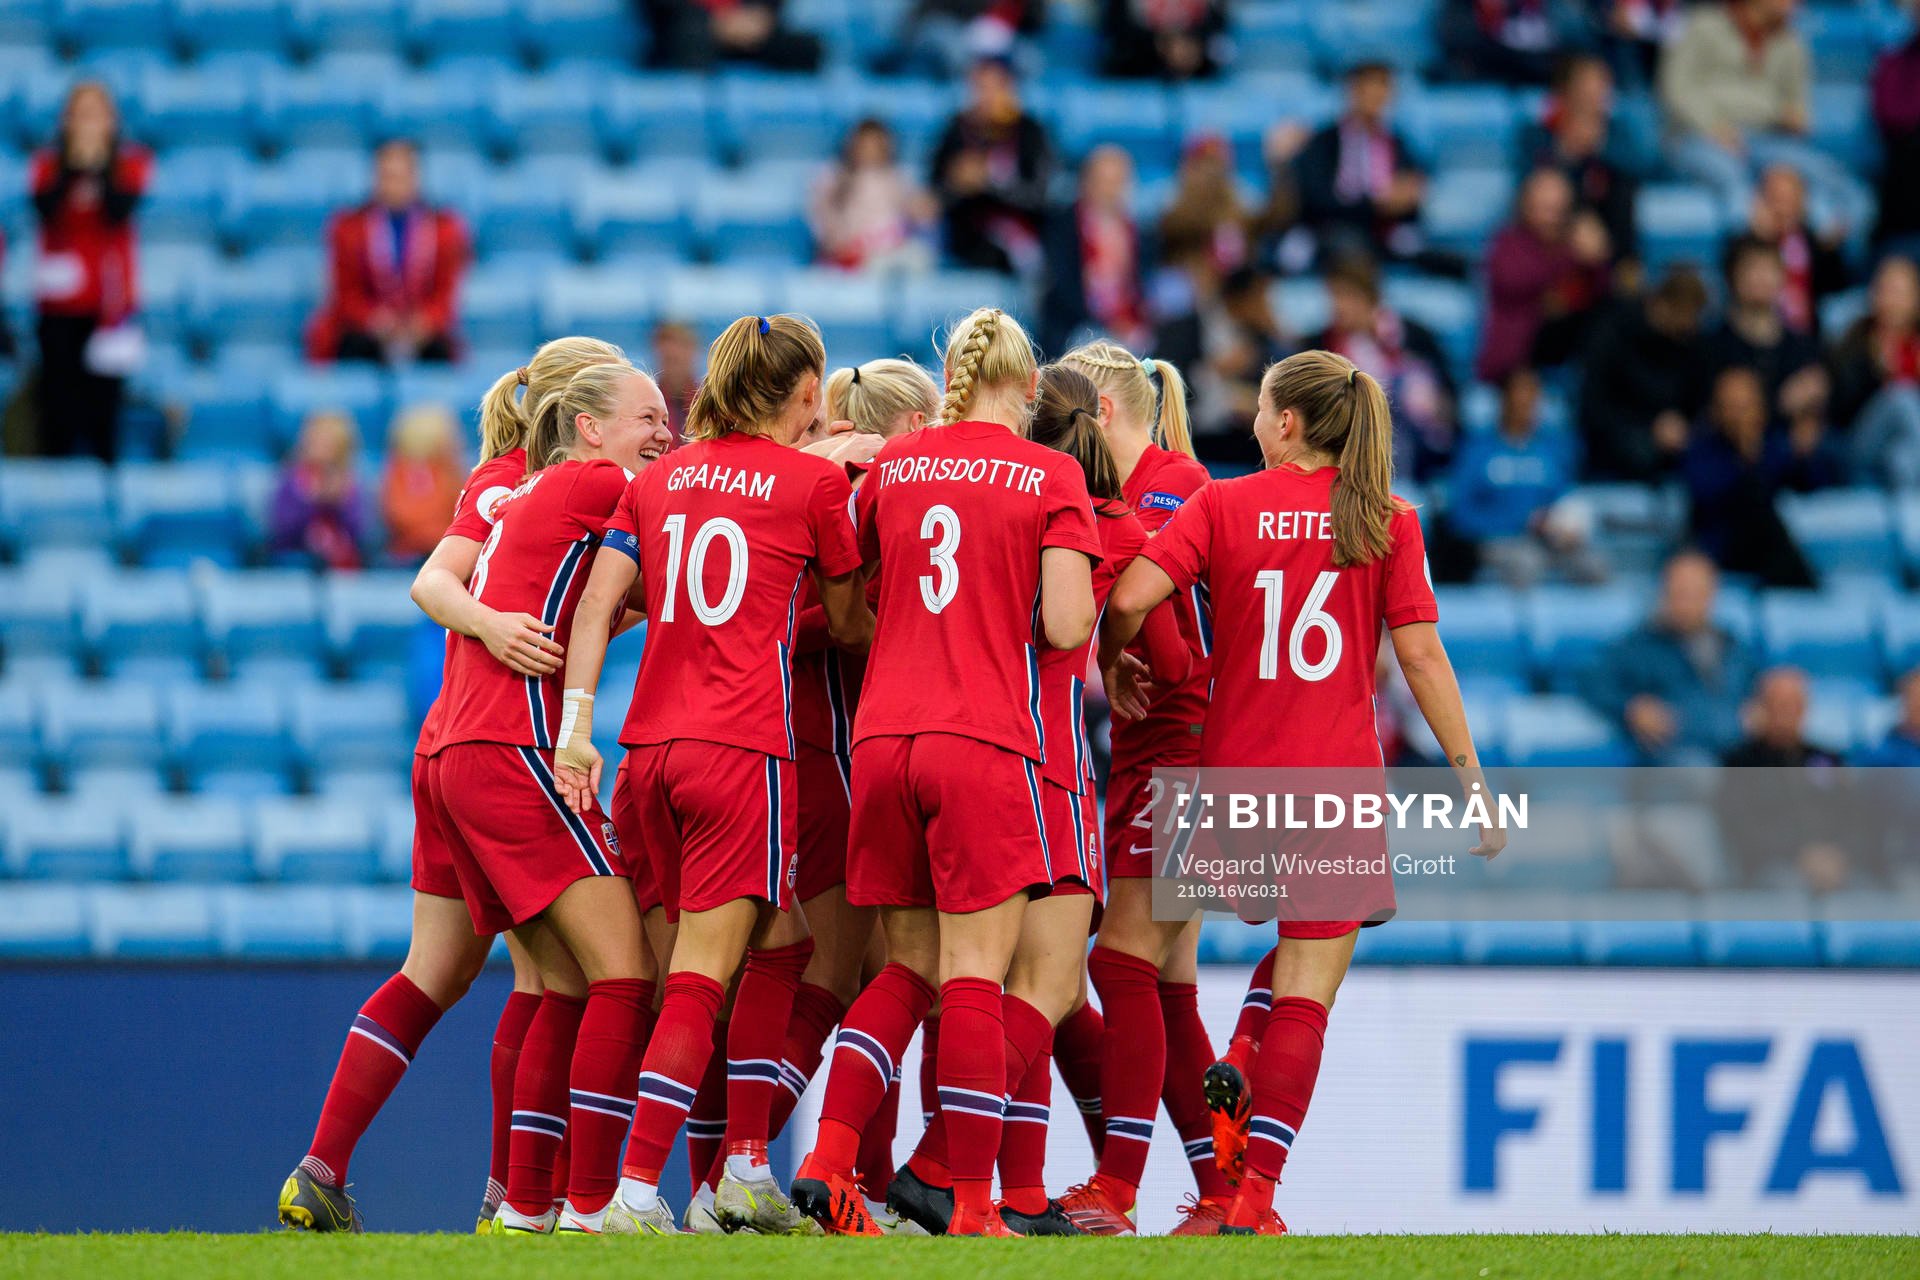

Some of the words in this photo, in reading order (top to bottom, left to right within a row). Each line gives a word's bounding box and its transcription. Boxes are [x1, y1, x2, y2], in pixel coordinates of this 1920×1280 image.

[667, 463, 776, 501] GRAHAM
[879, 456, 1046, 496] THORISDOTTIR
[1154, 496, 1182, 508] RESPE
[1258, 511, 1336, 540] REITE
[661, 514, 749, 627] 10
[919, 504, 961, 615] 3
[1253, 570, 1343, 682] 16
[1131, 778, 1187, 835] 21
[1460, 1034, 1907, 1195] FIFA
